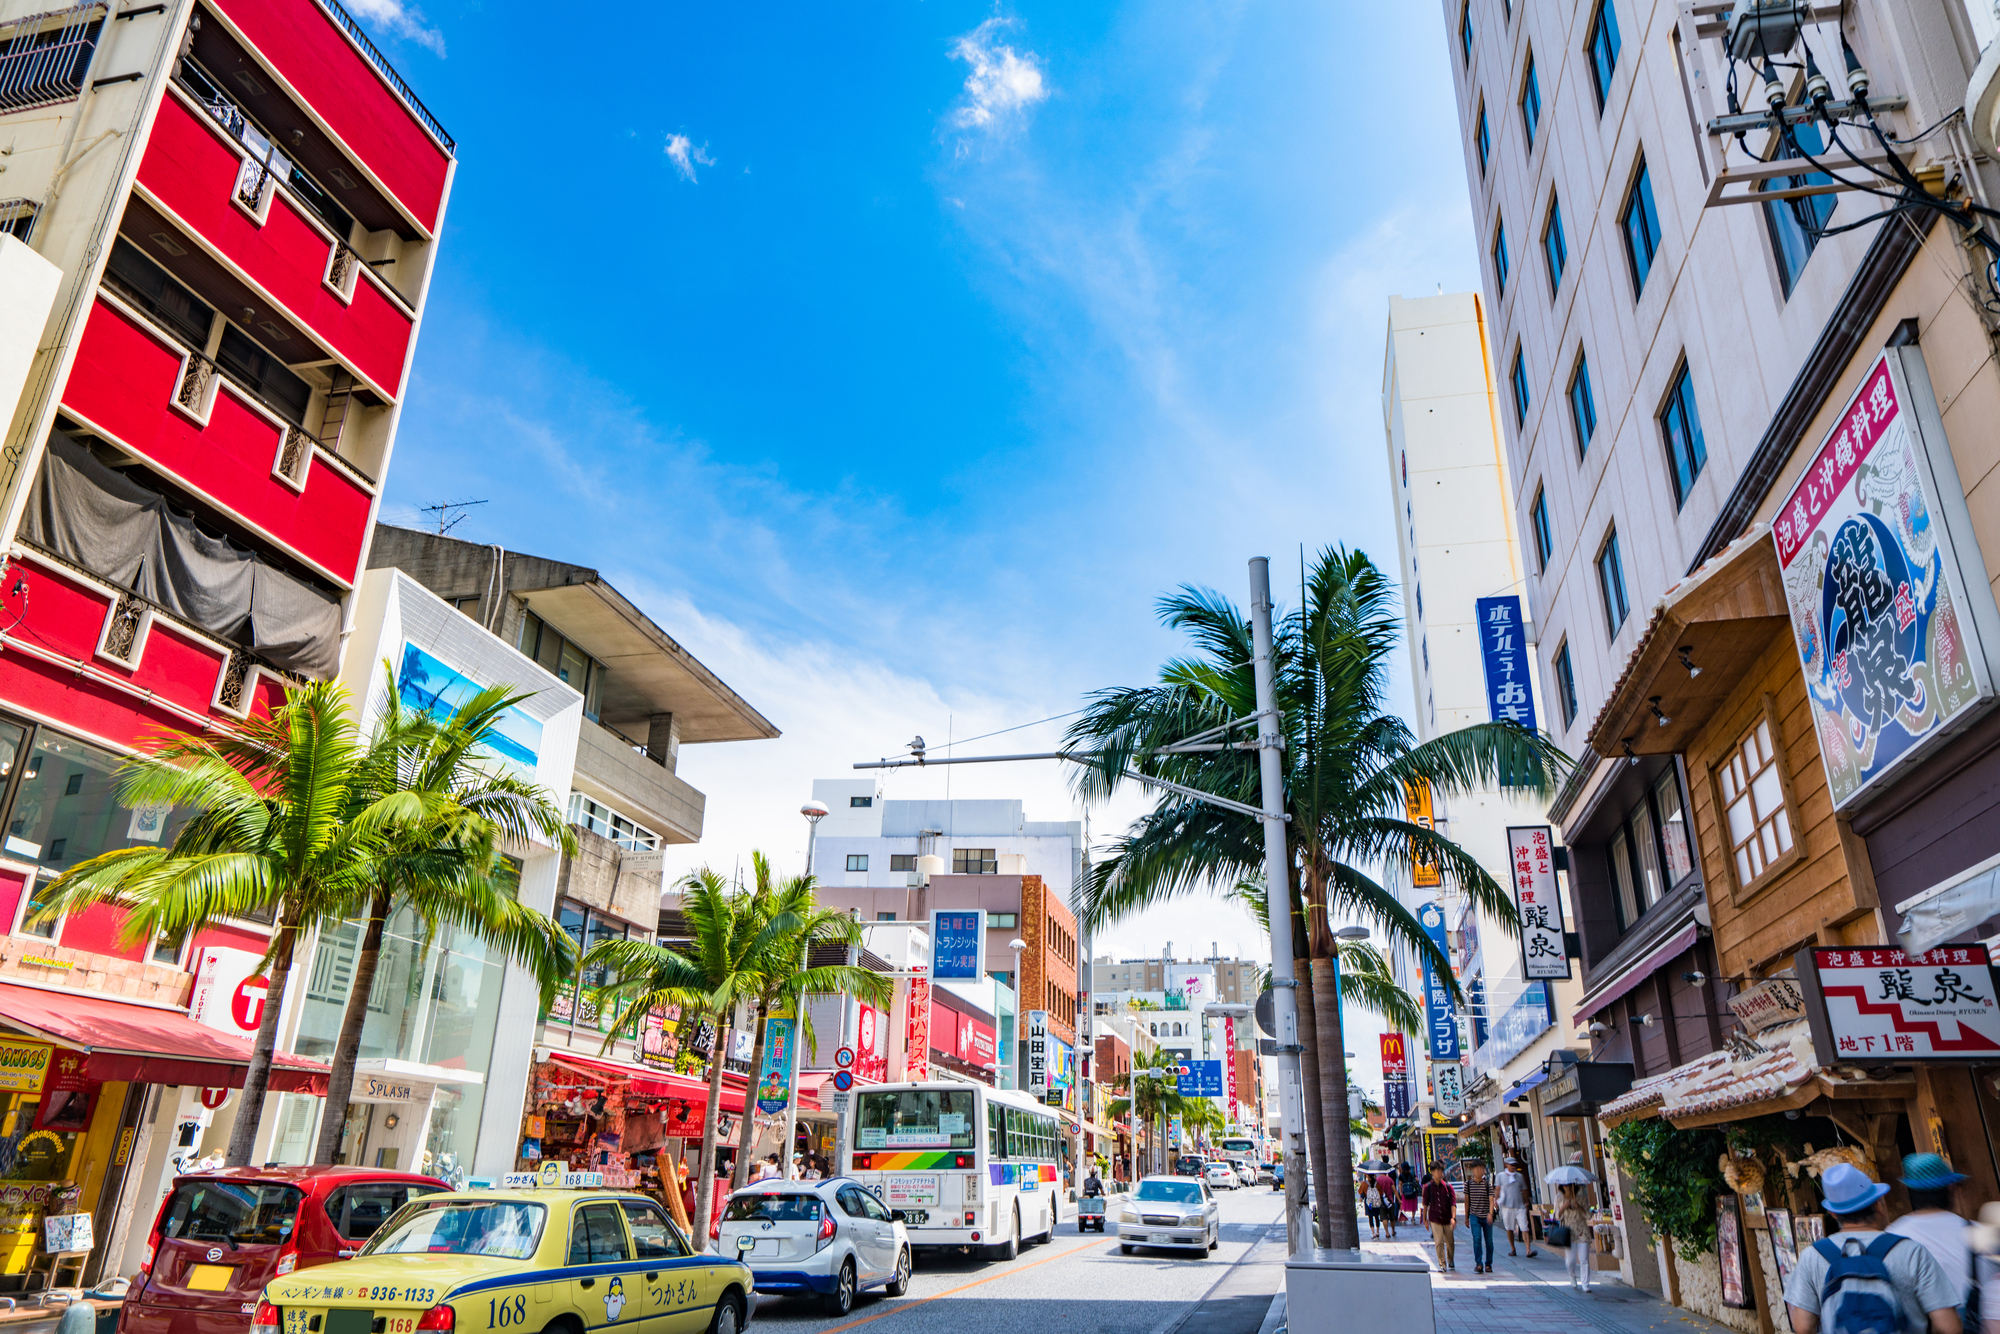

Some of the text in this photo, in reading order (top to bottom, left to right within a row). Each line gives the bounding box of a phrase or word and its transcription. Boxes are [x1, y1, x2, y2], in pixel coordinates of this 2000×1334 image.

[1778, 375, 1894, 559] 泡盛と沖縄料理
[1895, 580, 1916, 634] 盛
[1532, 831, 1550, 874] 泡盛と
[1515, 845, 1536, 904] 沖縄料理
[940, 917, 975, 930] 日曜日
[1523, 905, 1561, 958] 龍泉
[936, 936, 978, 949] トランジット
[937, 955, 976, 968] モール実施
[1827, 948, 1971, 967] 泡盛と沖縄料理
[1878, 967, 1985, 1006] 龍泉
[195, 988, 207, 1022] CLOTH
[241, 984, 269, 1024] T
[1936, 1009, 1957, 1017] Dining
[1838, 1033, 1915, 1053] 地下1階
[0, 1046, 48, 1070] ONOOS
[1031, 1024, 1045, 1086] 山田宝石
[207, 1087, 224, 1105] T
[368, 1079, 411, 1099] SPLASH
[505, 1174, 537, 1186] つかざん
[564, 1173, 581, 1186] 168
[890, 1177, 936, 1185] ドコモショップマチナト店
[281, 1285, 435, 1302] ペンギン無線 936-1133
[651, 1279, 698, 1307] つかざん
[286, 1309, 309, 1323] 追突
[487, 1294, 526, 1330] 168
[390, 1318, 413, 1333] 168
